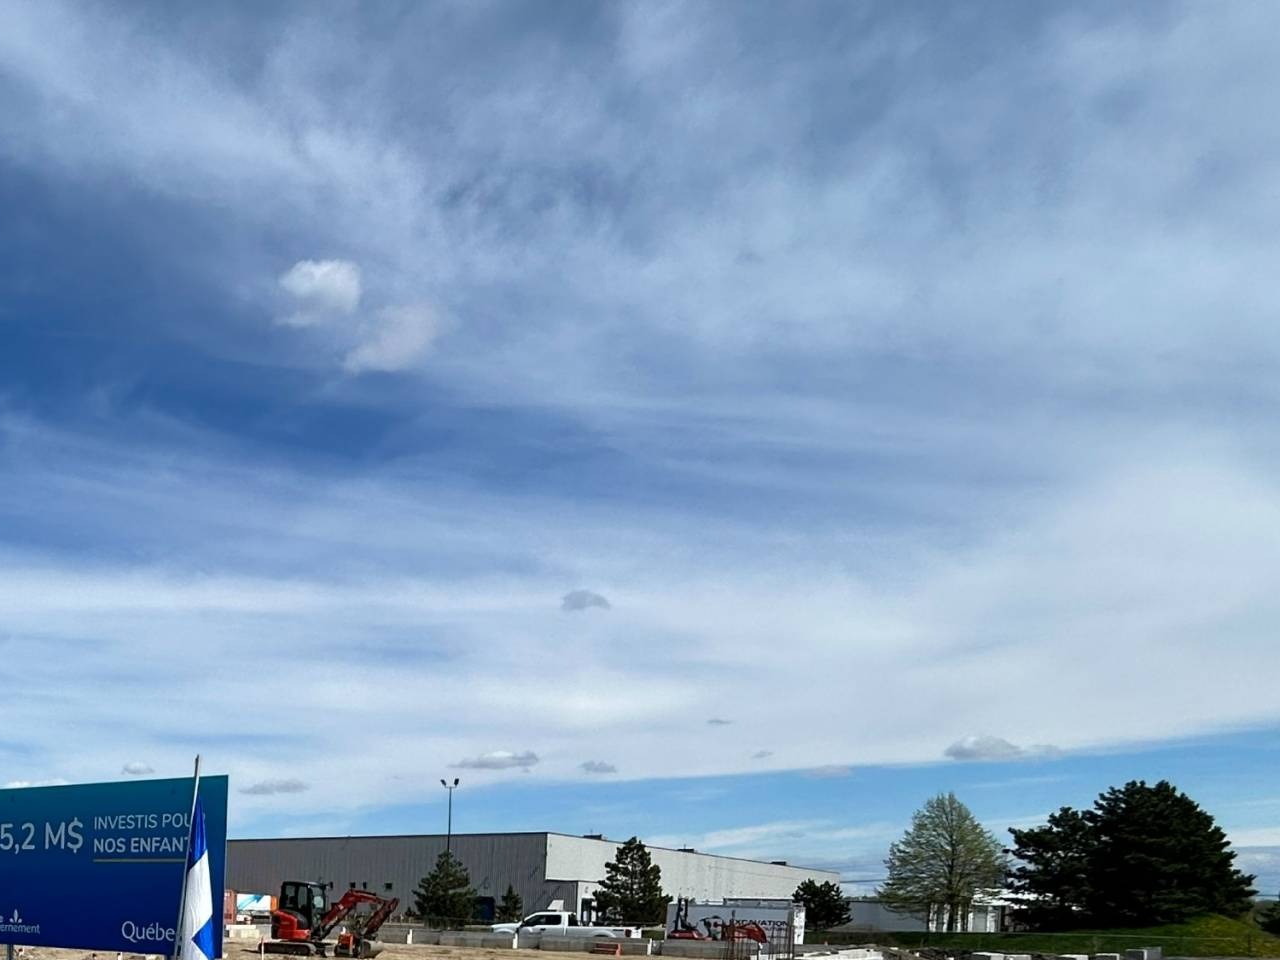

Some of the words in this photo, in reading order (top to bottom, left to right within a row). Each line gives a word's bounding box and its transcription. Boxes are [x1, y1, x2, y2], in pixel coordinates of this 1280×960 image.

[93, 813, 158, 831] INVESTIS
[162, 812, 205, 828] POU
[44, 816, 84, 854] M$
[93, 837, 126, 854] NOS
[130, 836, 190, 853] ENFAN
[121, 920, 176, 944] Québe
